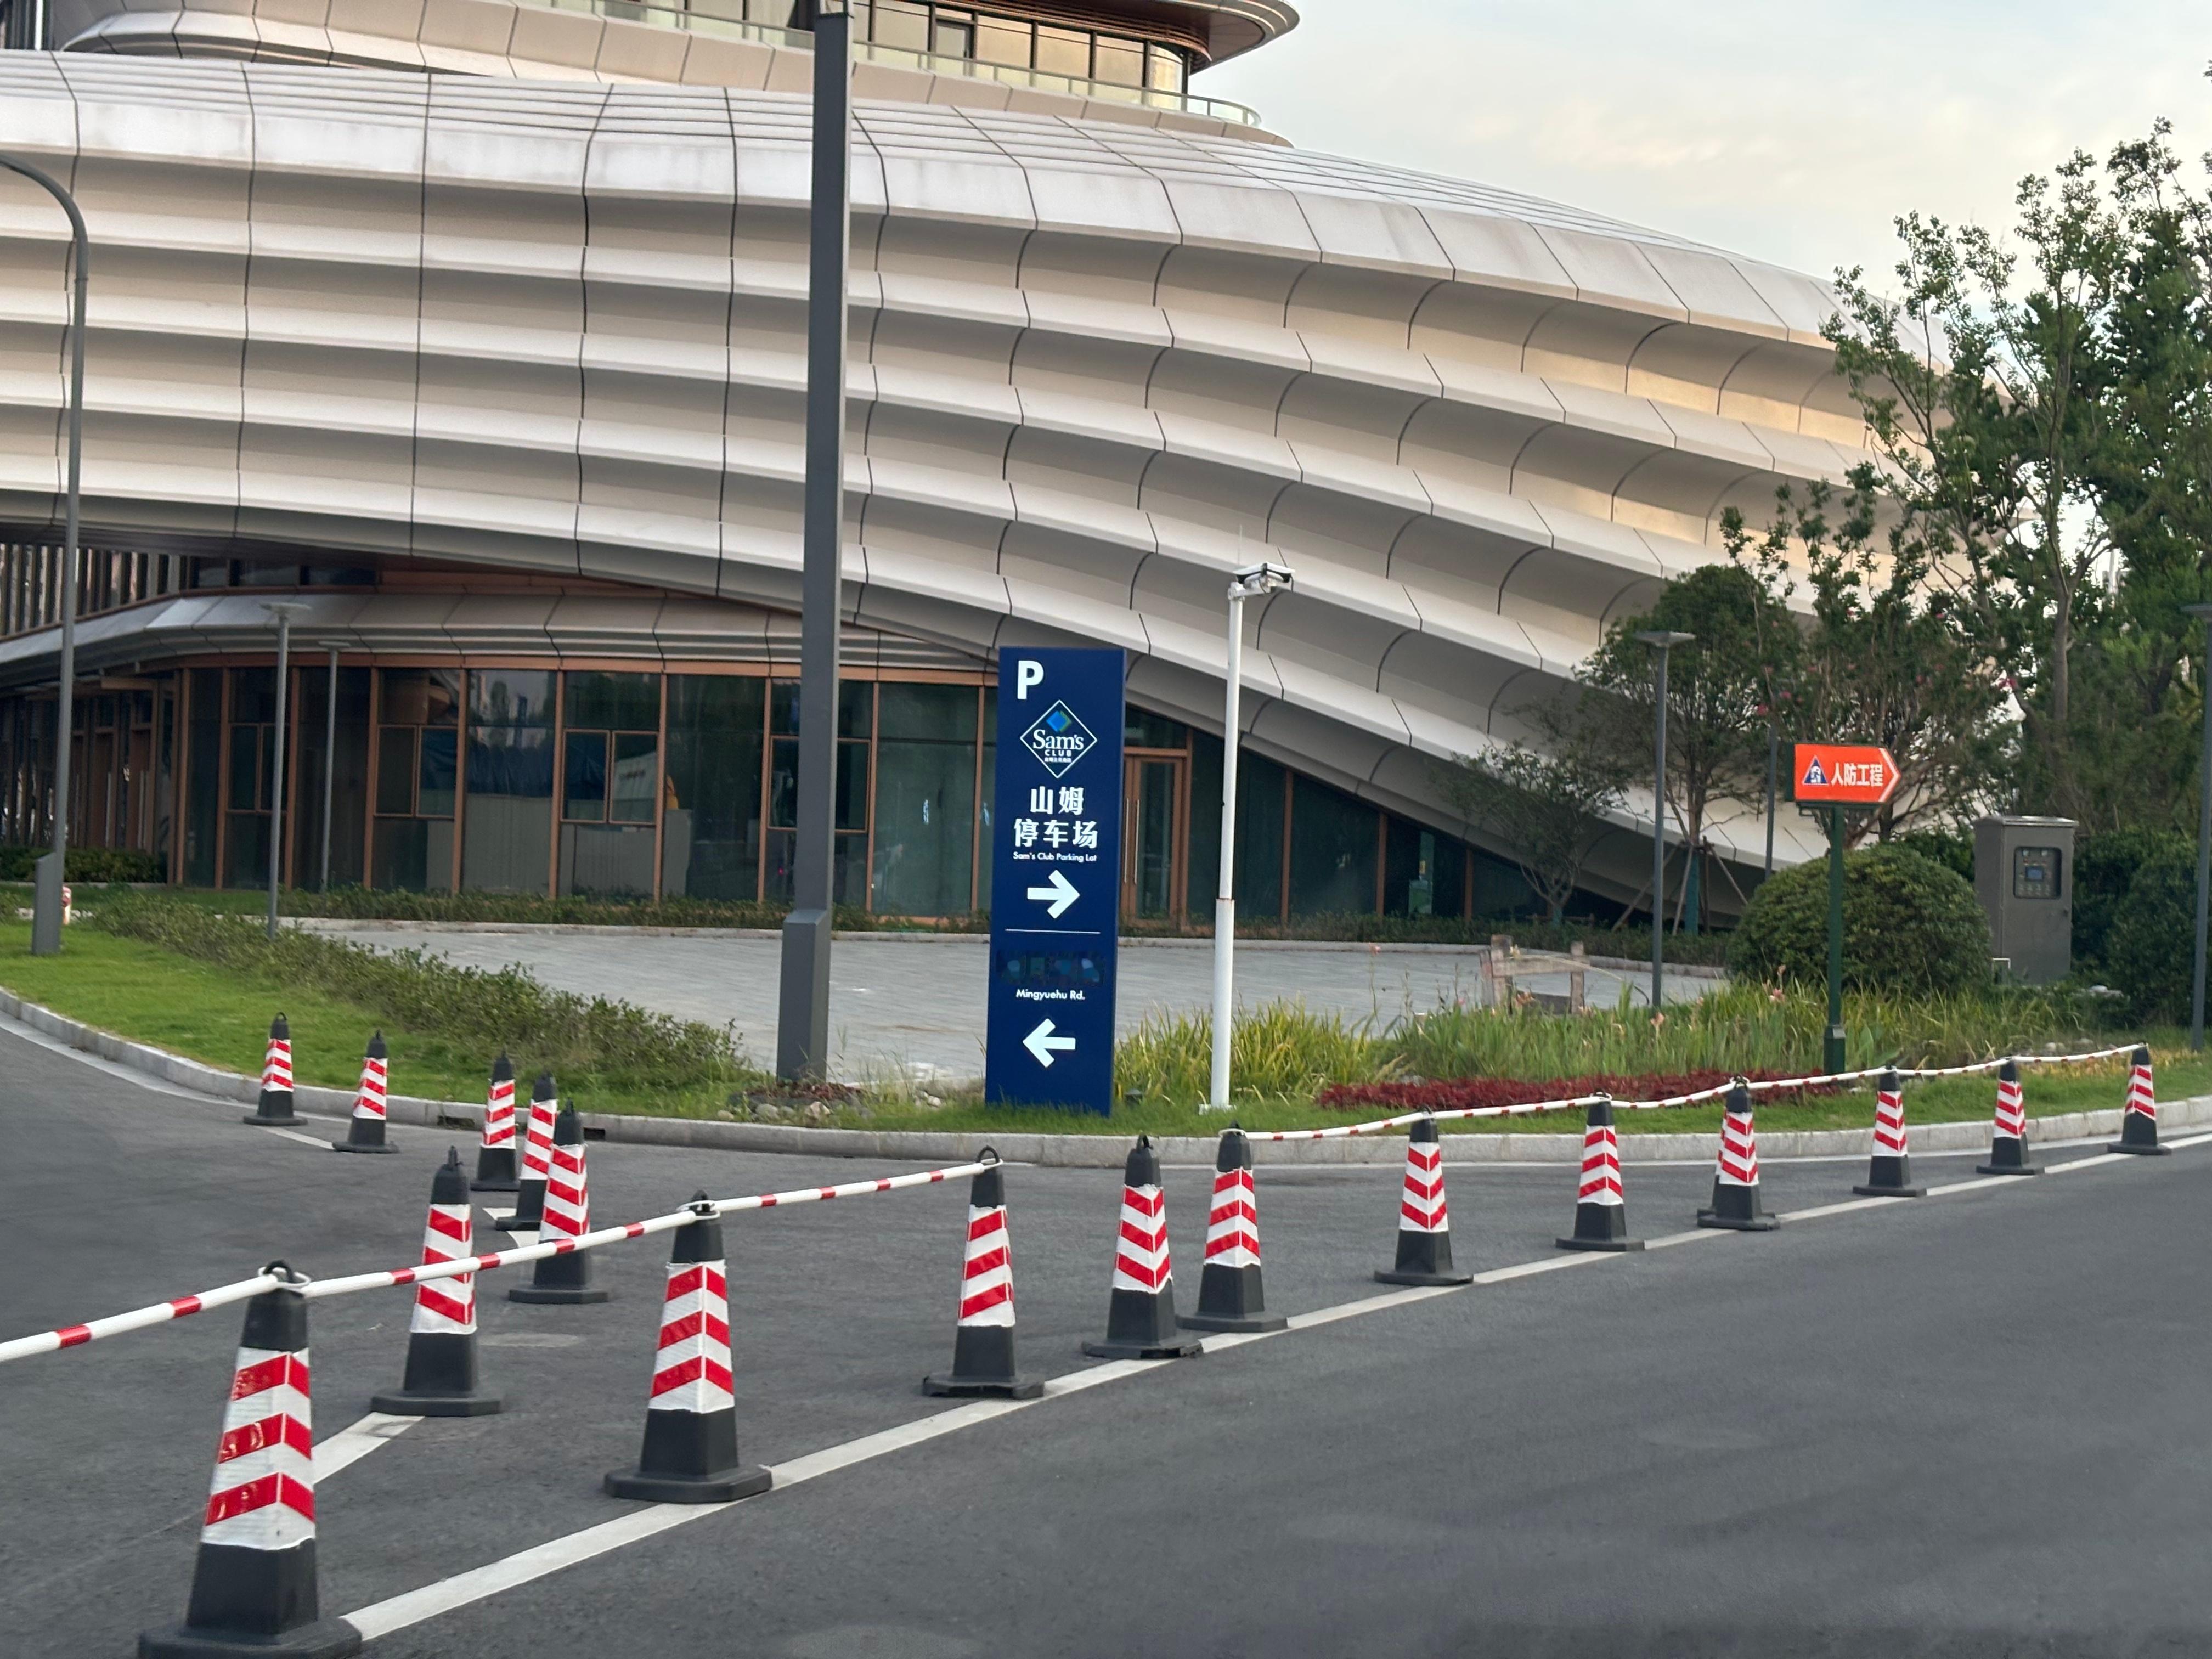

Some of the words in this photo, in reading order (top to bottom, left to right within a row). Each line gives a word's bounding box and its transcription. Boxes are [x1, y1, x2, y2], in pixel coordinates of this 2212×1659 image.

[1017, 660, 1044, 700] P
[1033, 729, 1084, 750] Sam's
[1831, 762, 1883, 787] 人防工程
[1030, 786, 1084, 815] 山姆
[1014, 818, 1098, 849] 停车场
[1013, 851, 1036, 860] Sam's
[1037, 852, 1055, 860] Club
[1056, 853, 1084, 863] Parking
[1016, 989, 1068, 1001] Mingyuehu
[1070, 990, 1086, 1000] Rd.
